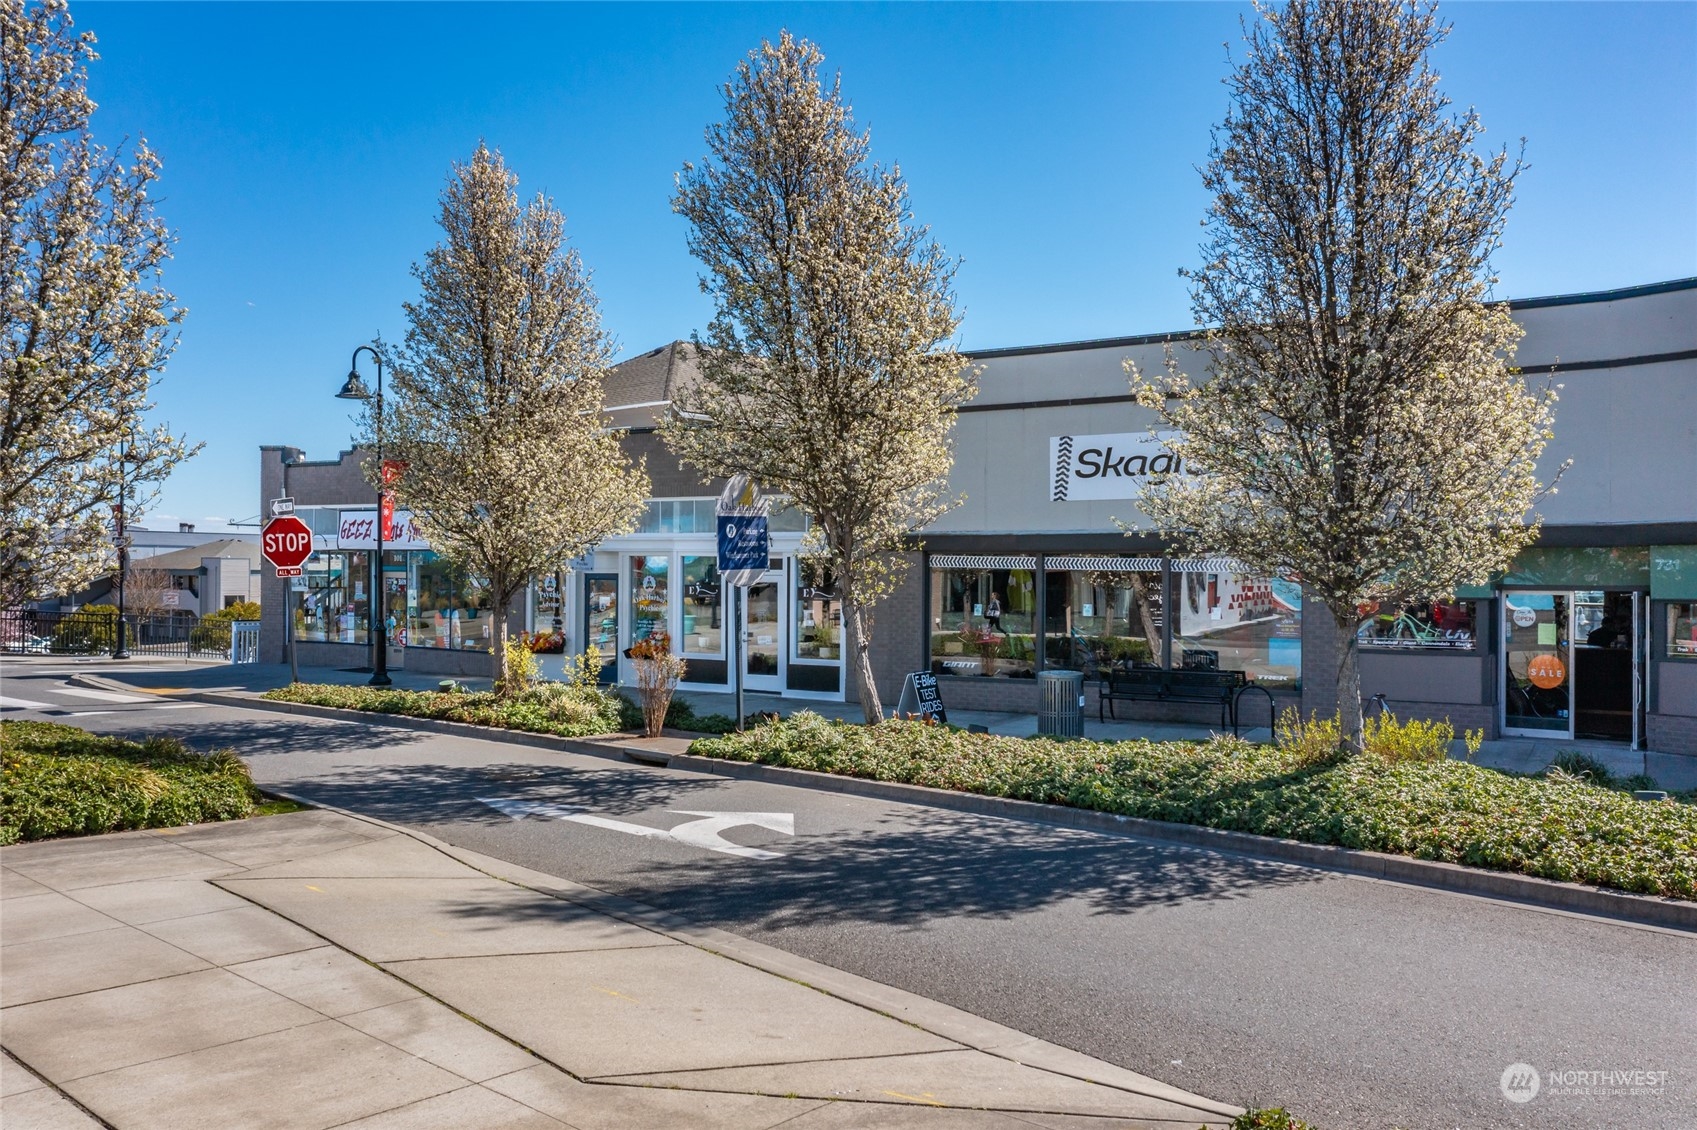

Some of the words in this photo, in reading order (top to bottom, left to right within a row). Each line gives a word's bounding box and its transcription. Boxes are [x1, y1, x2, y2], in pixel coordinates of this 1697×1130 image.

[721, 495, 737, 511] Oak
[340, 519, 373, 541] GEEZ
[265, 533, 309, 553] STOP
[942, 660, 979, 669] GIANT
[1530, 668, 1563, 678] SALE
[914, 674, 937, 687] E-Bike
[920, 688, 937, 700] TEST
[921, 700, 943, 713] RIDES
